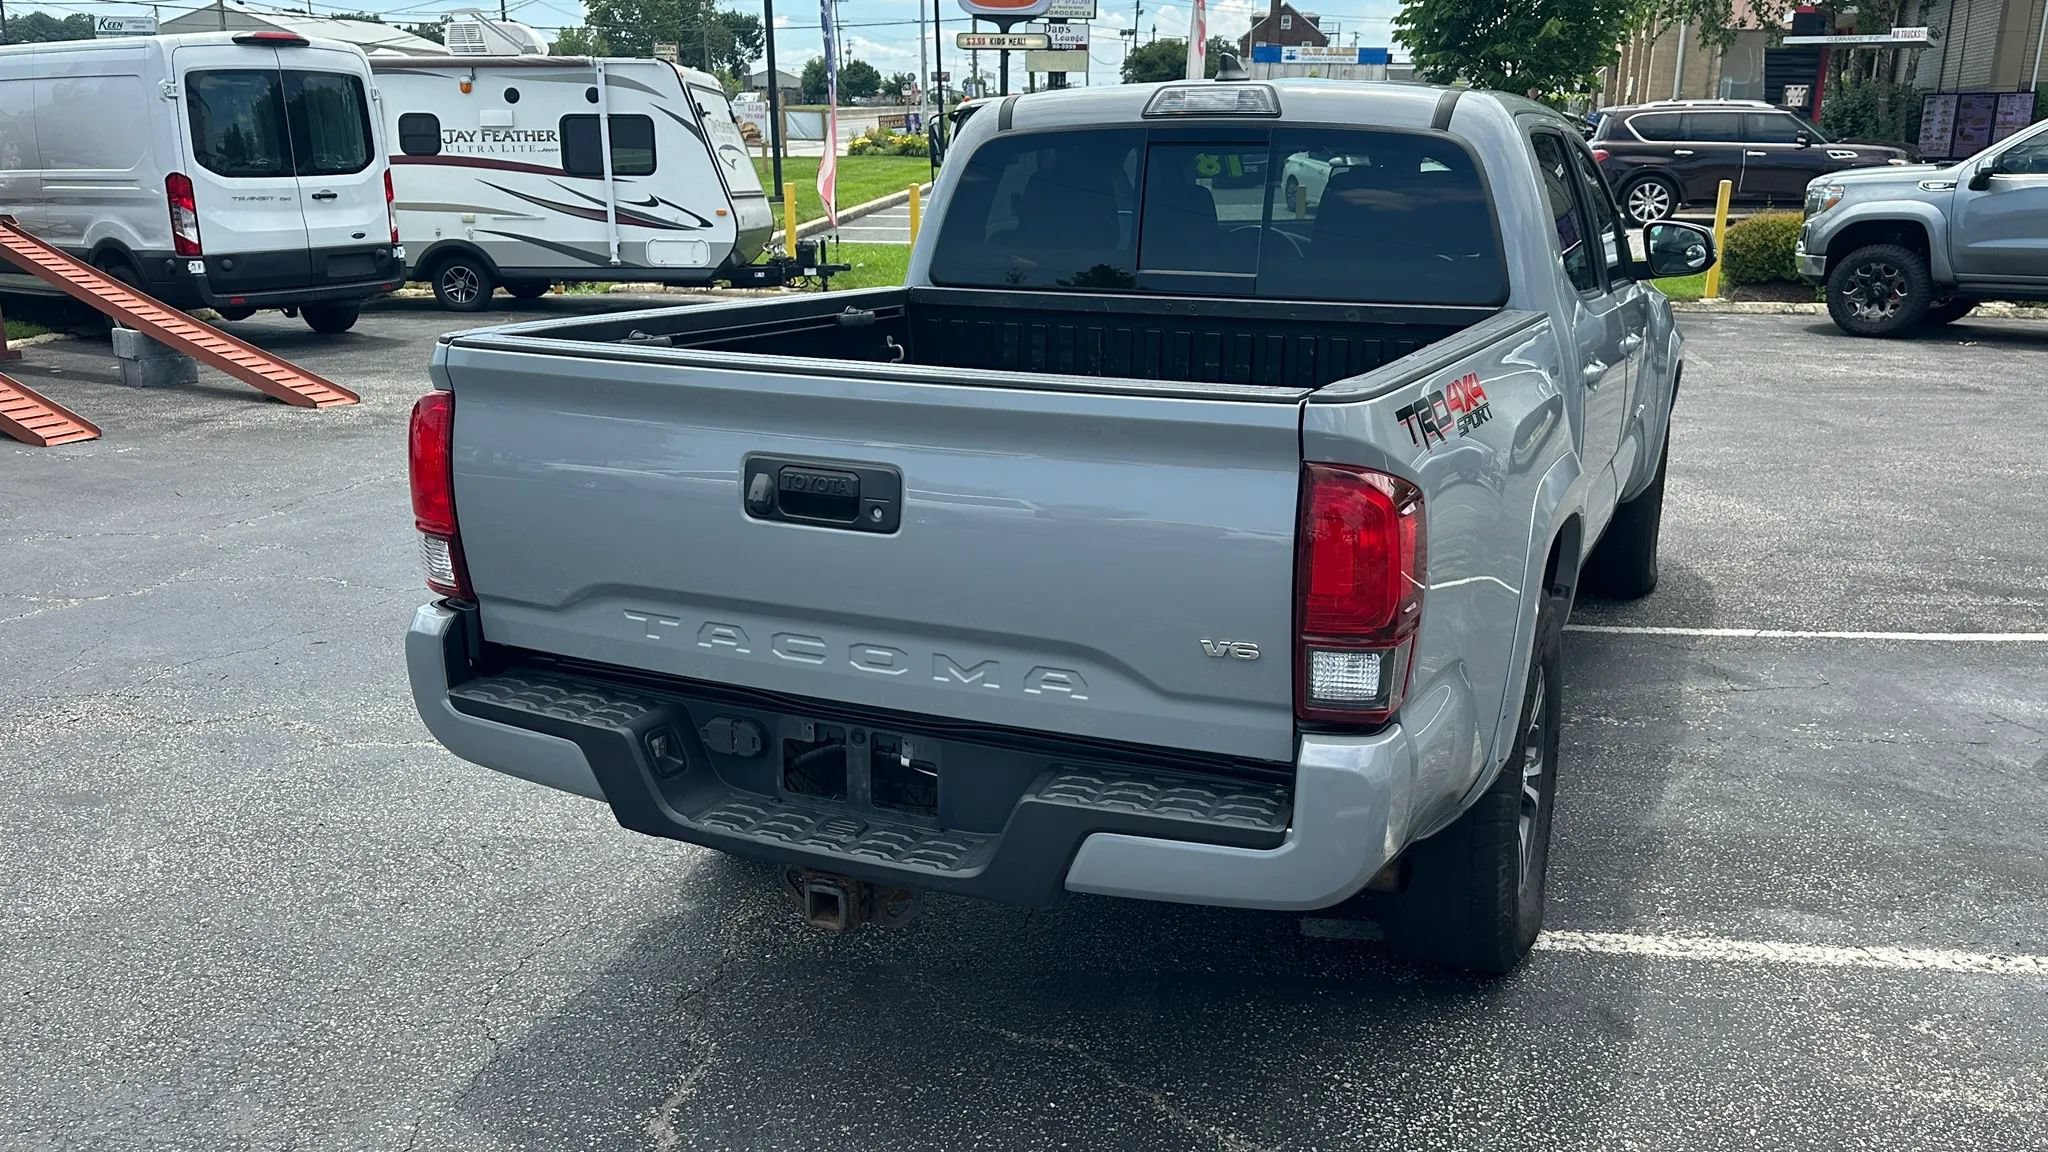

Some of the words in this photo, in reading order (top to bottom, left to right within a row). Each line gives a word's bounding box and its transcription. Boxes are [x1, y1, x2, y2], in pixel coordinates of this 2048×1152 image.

[98, 18, 123, 30] KEEN
[1044, 24, 1071, 34] Dan's
[1055, 34, 1084, 44] Lounge
[1892, 30, 1899, 39] NO
[966, 38, 986, 46] $3.99
[989, 37, 1006, 46] KIDS
[442, 129, 477, 144] JAY
[480, 129, 559, 143] FEATHER
[445, 145, 495, 153] ULTRA
[501, 144, 536, 153] LITE
[1395, 389, 1455, 454] TRD
[1456, 401, 1493, 438] SPORT
[783, 473, 849, 495] TOYOTA
[623, 608, 1088, 701] TACOMA
[1200, 637, 1261, 661] V6
